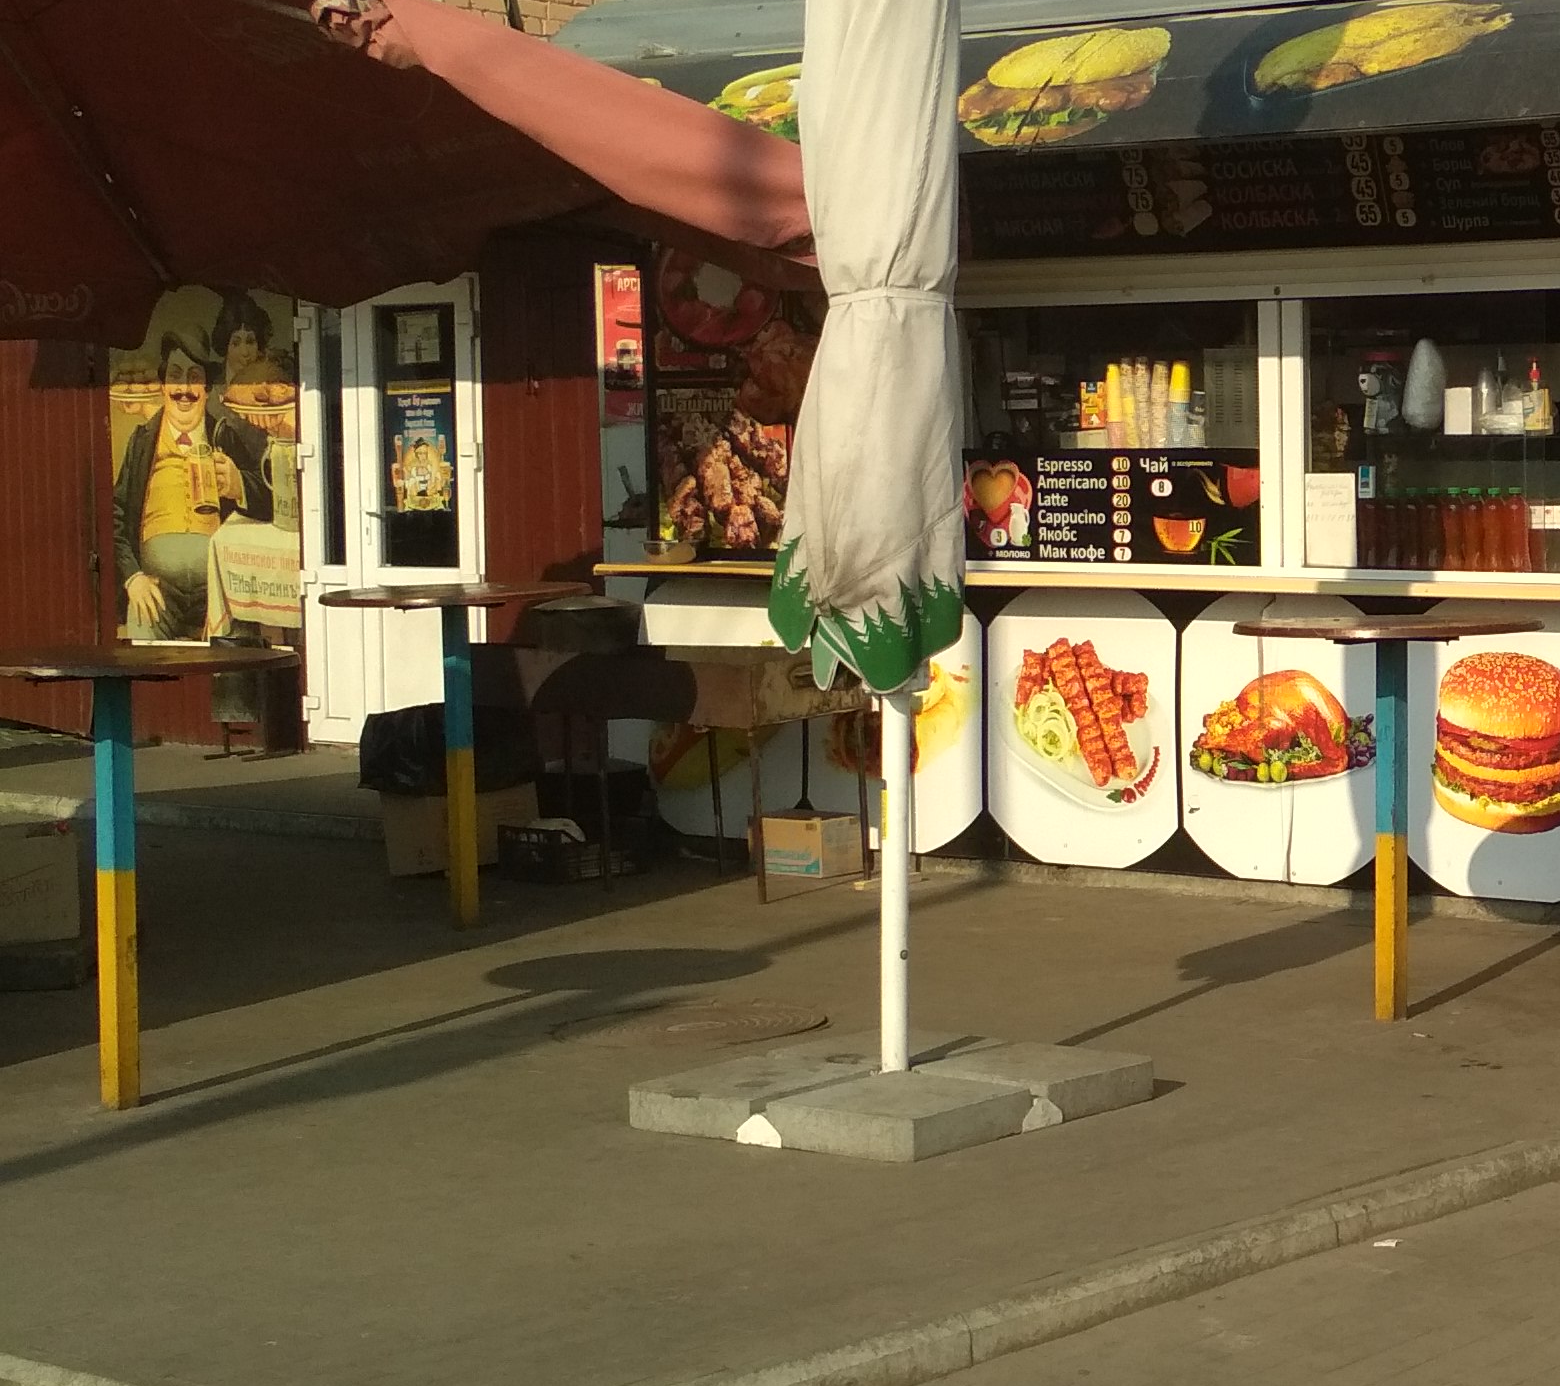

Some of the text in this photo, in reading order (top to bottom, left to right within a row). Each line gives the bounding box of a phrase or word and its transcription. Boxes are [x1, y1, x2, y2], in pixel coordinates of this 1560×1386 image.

[1430, 139, 1466, 152] Плов
[1212, 158, 1299, 180] СОСИСКА
[1351, 153, 1369, 172] 45
[1433, 157, 1474, 175] Борщ
[1216, 182, 1315, 205] КОЛБАСКА
[1356, 179, 1374, 198] 45
[1436, 178, 1461, 193] Суп
[1501, 192, 1541, 211] борщ
[1221, 208, 1320, 231] КОЛБАСКА
[1360, 205, 1377, 223] 55
[1441, 213, 1490, 232] Шурпа
[1037, 457, 1129, 474] Espresso 10
[1140, 457, 1169, 474] Чай
[1037, 474, 1130, 490] Americano 10
[1037, 492, 1130, 508] Latte 20
[1038, 509, 1130, 528] Cappucino 20
[1188, 520, 1201, 533] 10
[1039, 526, 1078, 542] Якобс
[1039, 544, 1068, 560] Мак
[1070, 545, 1106, 562] кофе
